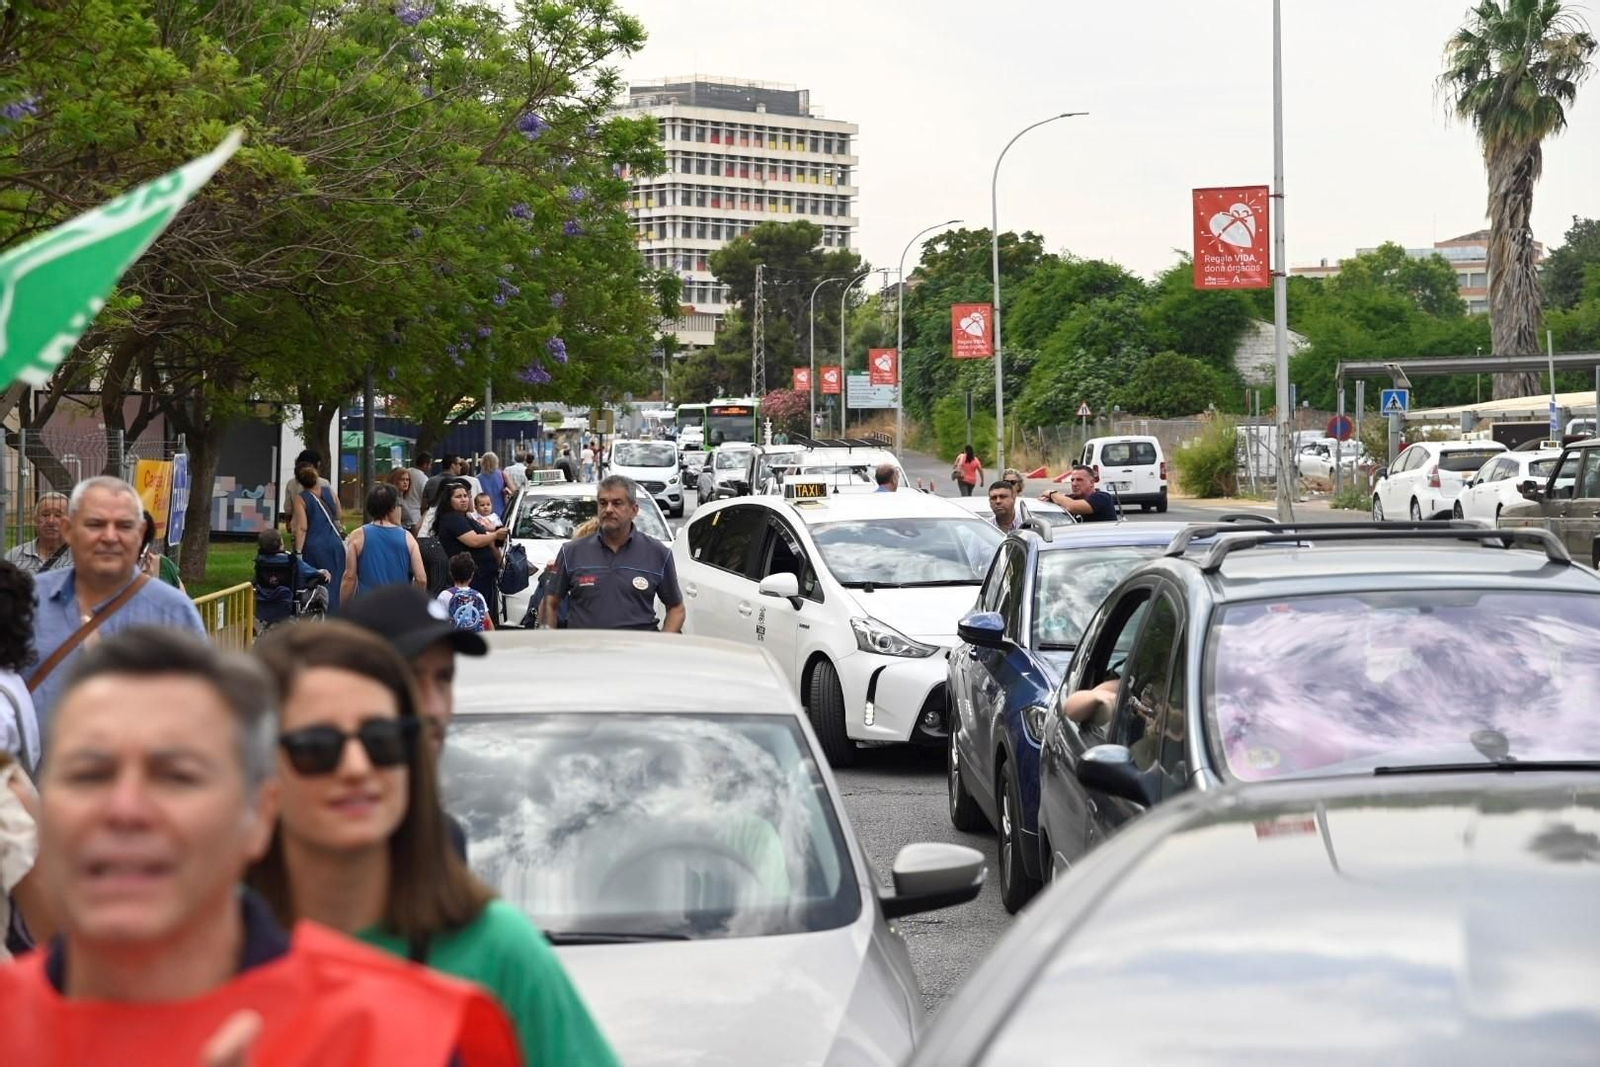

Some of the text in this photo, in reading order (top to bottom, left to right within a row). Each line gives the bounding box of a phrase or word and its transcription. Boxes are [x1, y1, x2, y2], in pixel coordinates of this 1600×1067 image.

[1204, 254, 1257, 264] Regala VIDA,
[1204, 264, 1261, 273] dona órganos
[795, 484, 818, 497] TAXI
